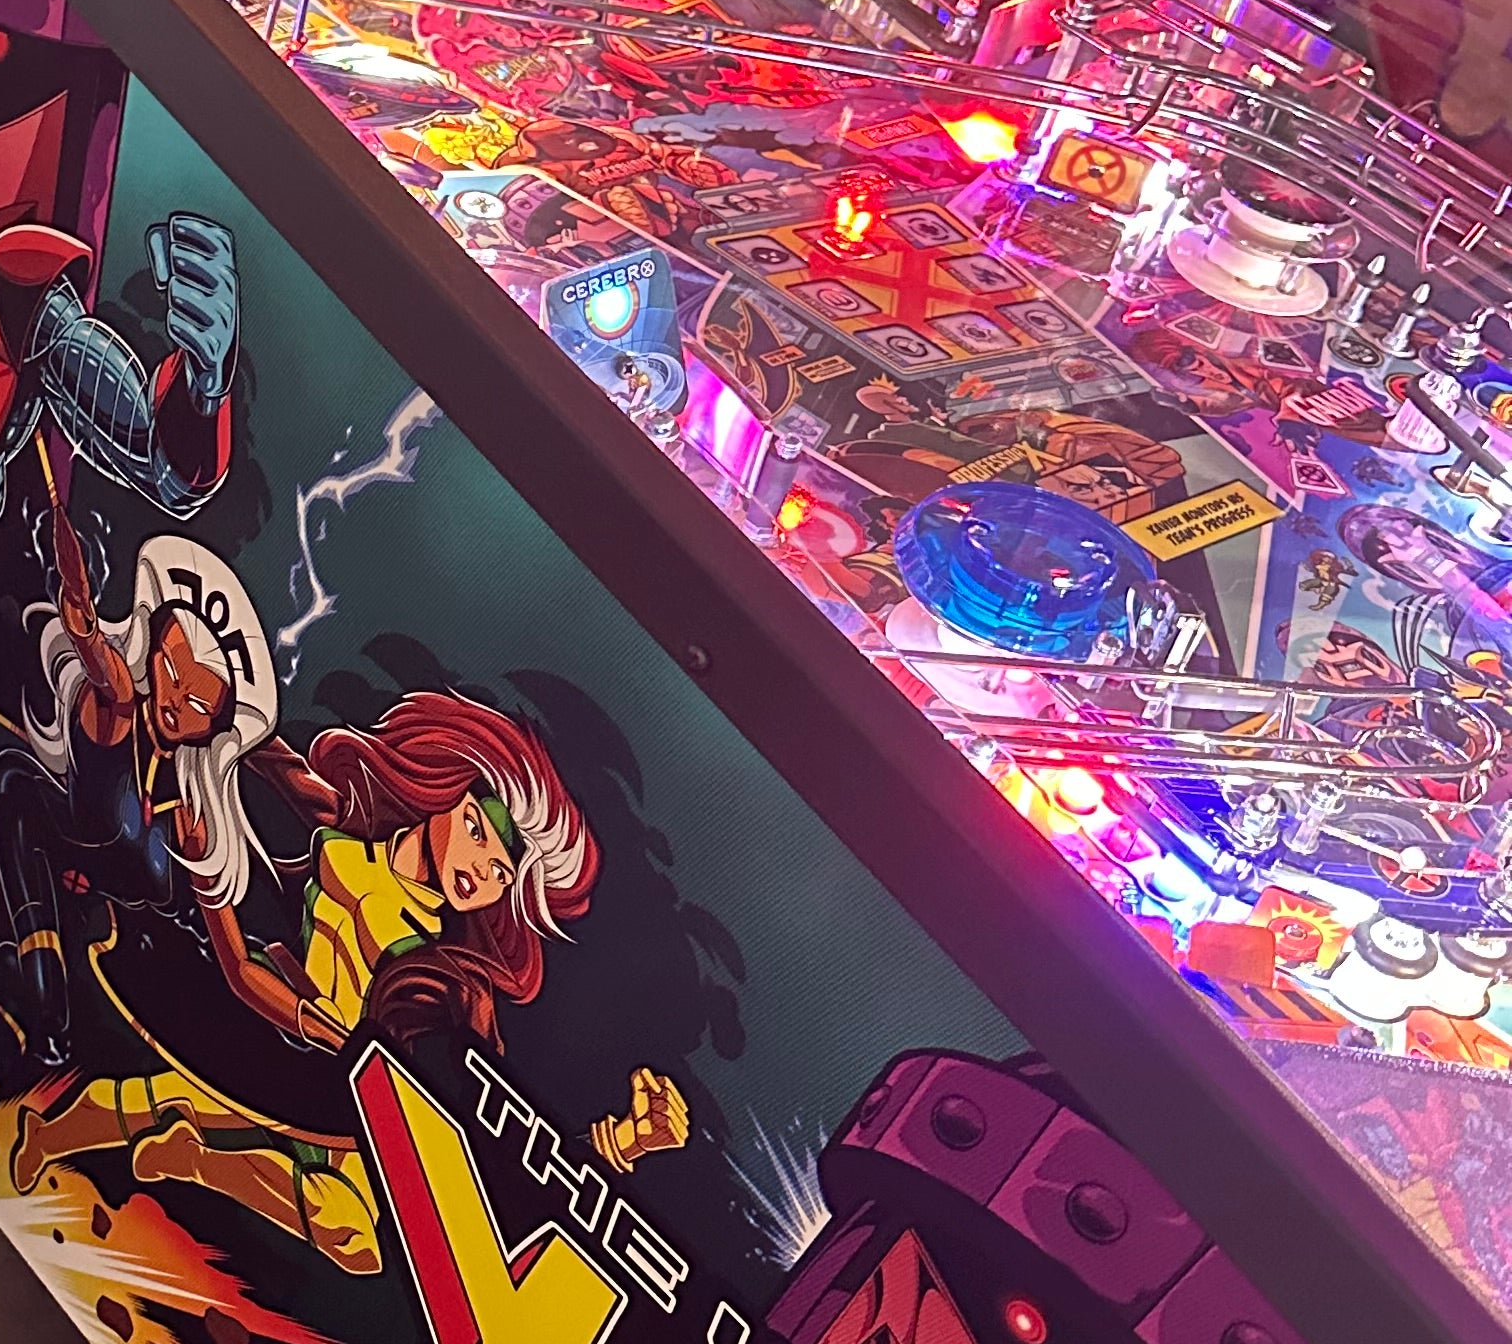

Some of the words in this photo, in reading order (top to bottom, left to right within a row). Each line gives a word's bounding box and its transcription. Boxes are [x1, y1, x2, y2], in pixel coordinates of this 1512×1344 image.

[561, 258, 656, 304] CEREBRO
[1145, 514, 1183, 537] XAVIER
[1181, 497, 1229, 524] MONITORS
[1226, 492, 1246, 508] HIS
[1165, 523, 1205, 546] TEAM'S
[1204, 504, 1256, 533] PROGRESS
[464, 1047, 690, 1314] THE
